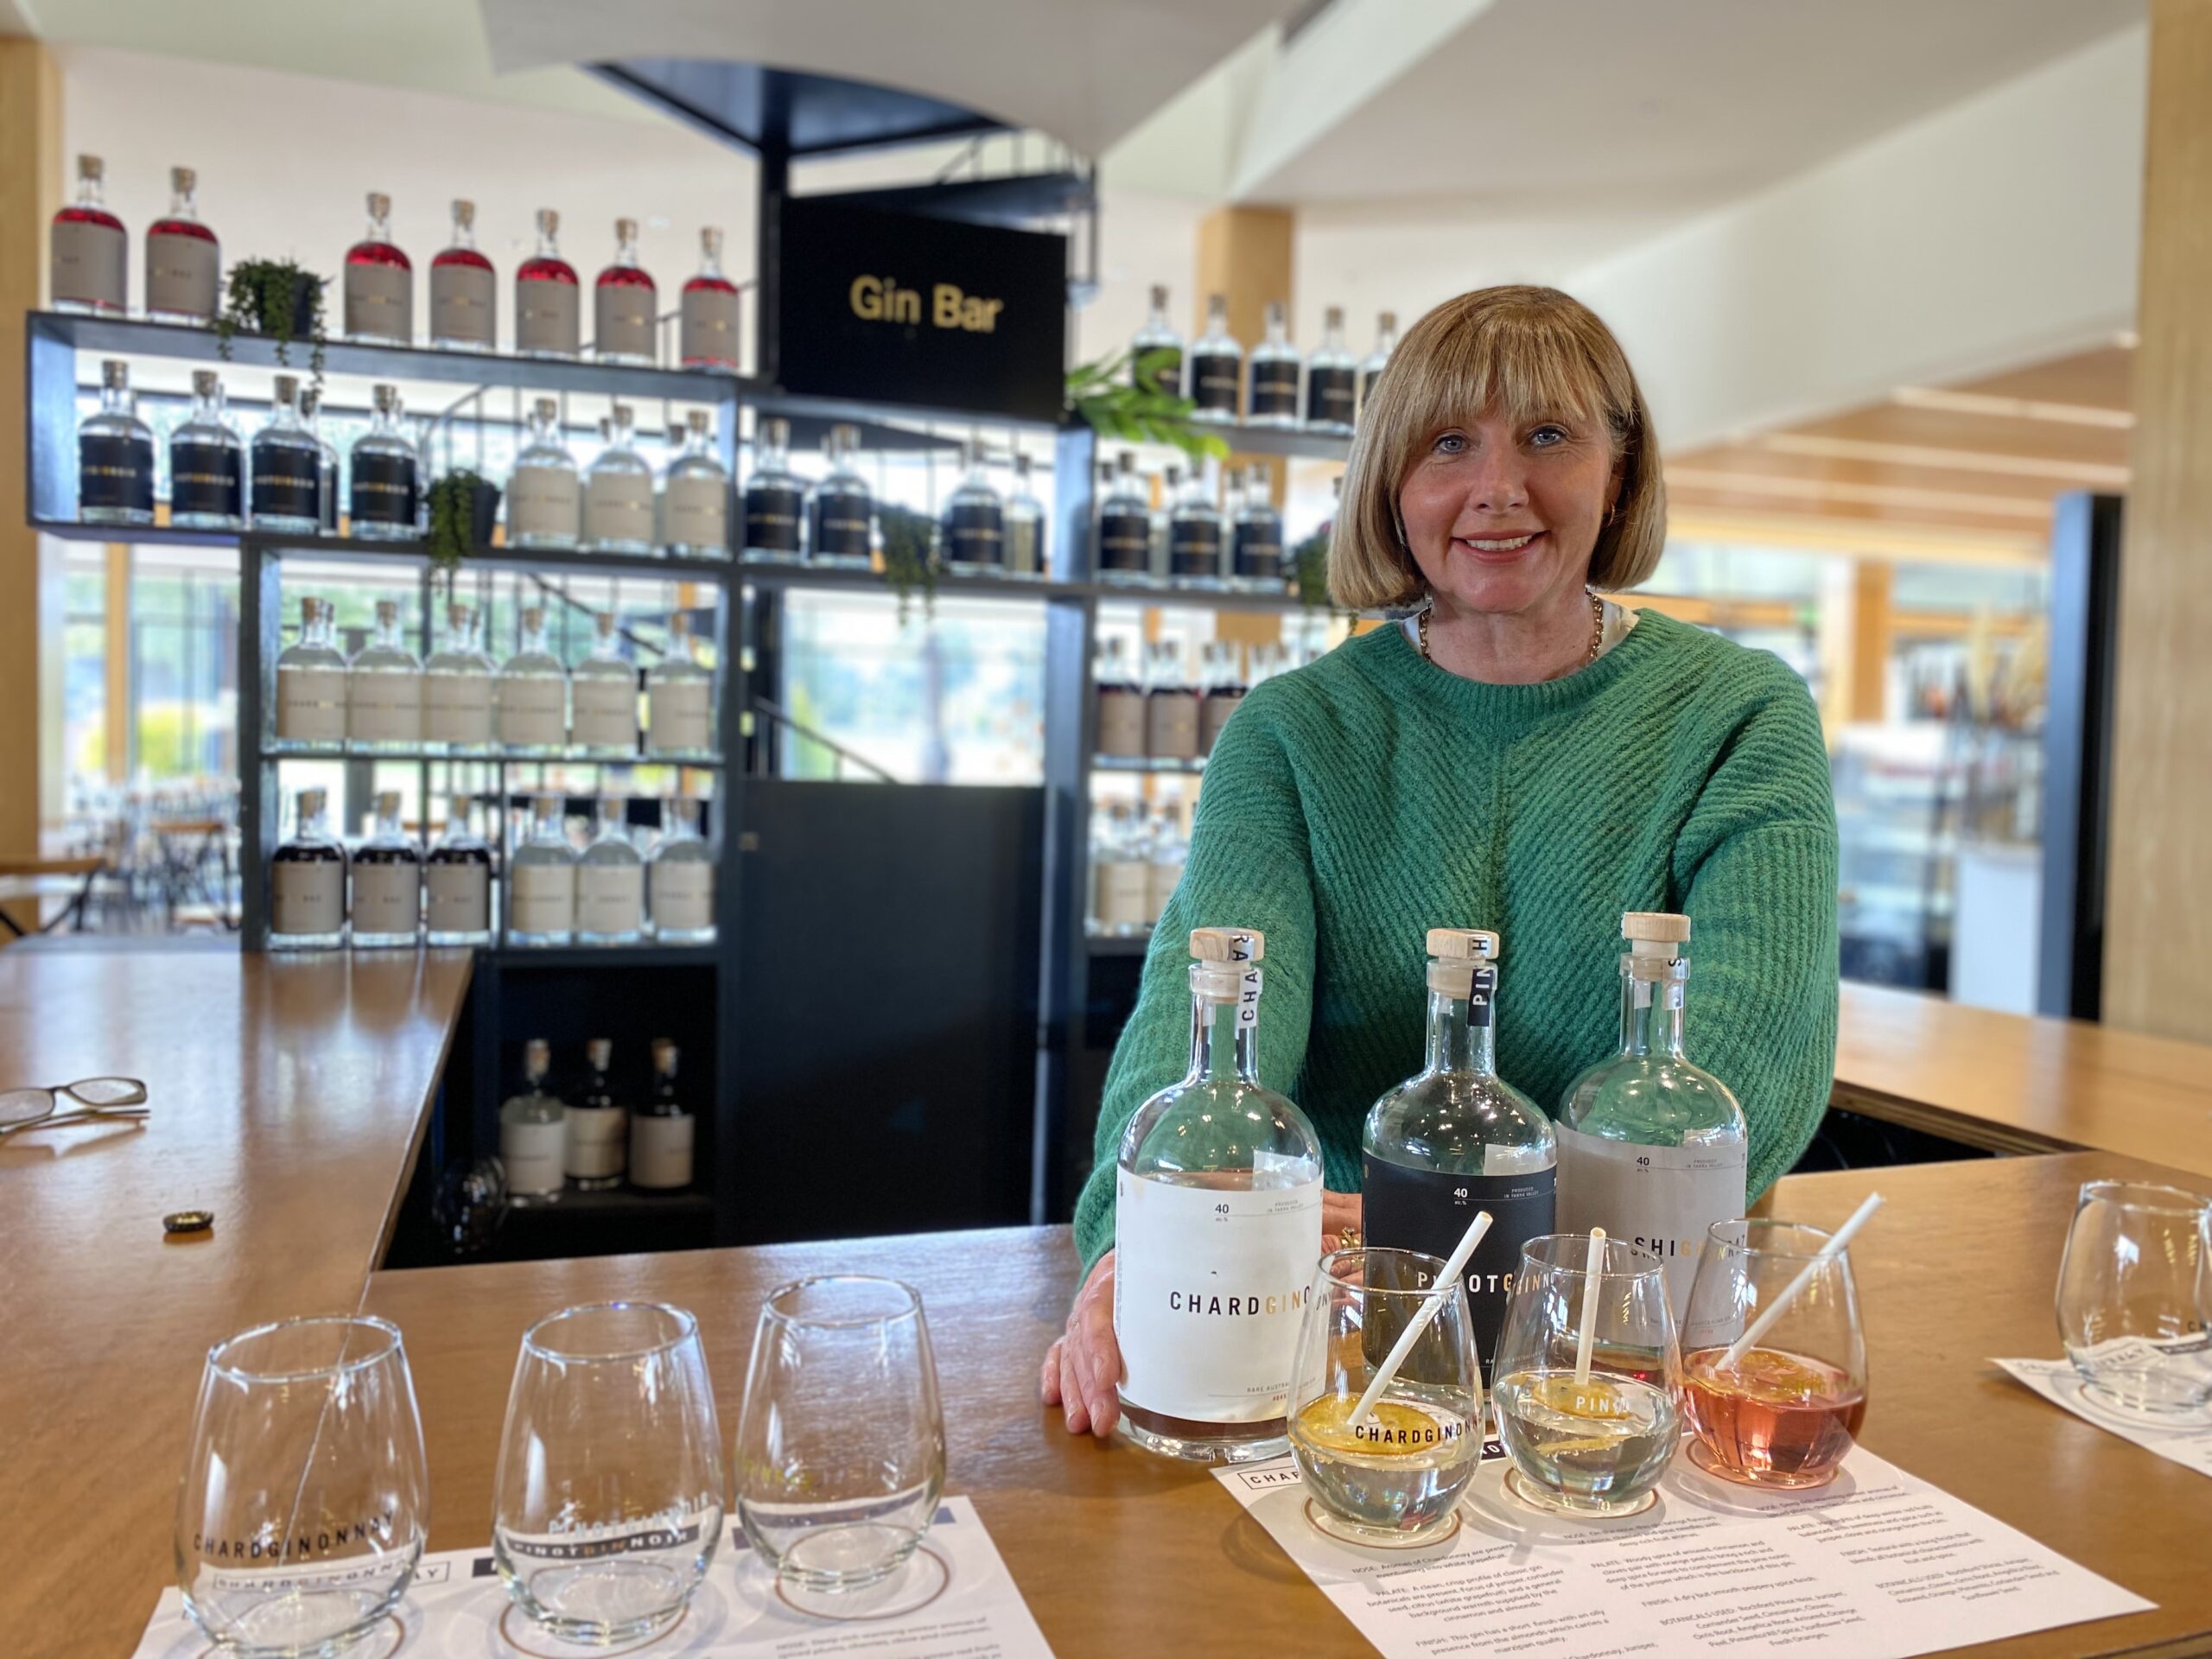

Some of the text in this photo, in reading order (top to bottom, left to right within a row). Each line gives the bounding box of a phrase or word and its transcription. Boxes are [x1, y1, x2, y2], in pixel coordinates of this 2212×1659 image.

[850, 275, 1003, 334] Gin Bar
[1637, 1156, 1649, 1166] 40
[1453, 1187, 1468, 1198] 40
[1215, 1204, 1230, 1214] 40
